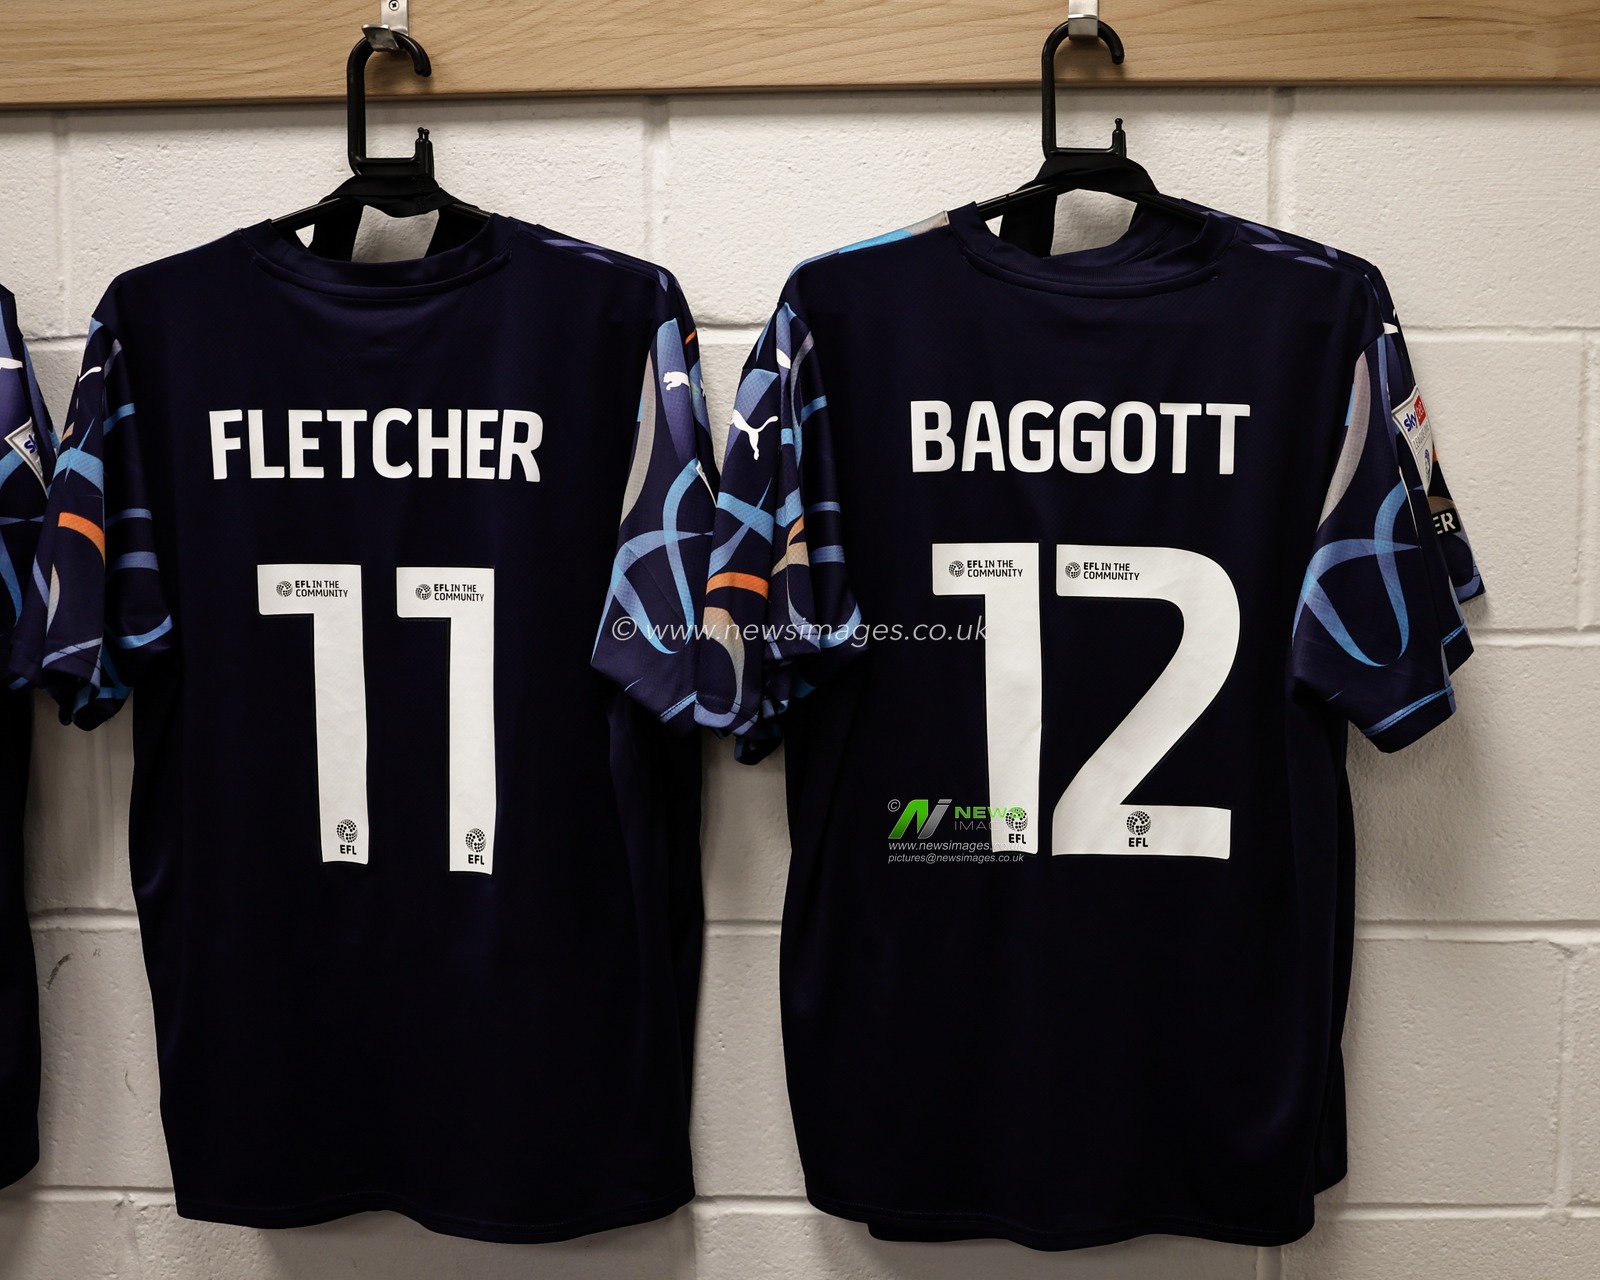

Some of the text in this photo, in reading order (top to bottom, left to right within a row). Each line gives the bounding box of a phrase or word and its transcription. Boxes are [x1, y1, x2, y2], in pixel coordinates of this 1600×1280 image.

[1404, 412, 1418, 432] sky
[910, 399, 1251, 475] BAGGOTT
[24, 434, 38, 454] sk
[208, 407, 544, 483] FLETCHER
[967, 560, 1014, 568] EFL IN THE
[1083, 562, 1130, 572] EFL IN THE
[967, 568, 1023, 577] COMMUNITY
[1083, 571, 1140, 581] COMMUNITY
[295, 580, 339, 589] EFL IN THE
[433, 583, 477, 593] EFL IN THE
[295, 588, 349, 598] COMMUNITY
[434, 592, 485, 602] COMMUNITY
[932, 542, 1241, 860] 12
[257, 563, 498, 875] 11
[1008, 833, 1027, 845] EFL
[1128, 837, 1149, 848] EFL
[339, 844, 357, 855] EFL
[467, 854, 485, 865] EFL
